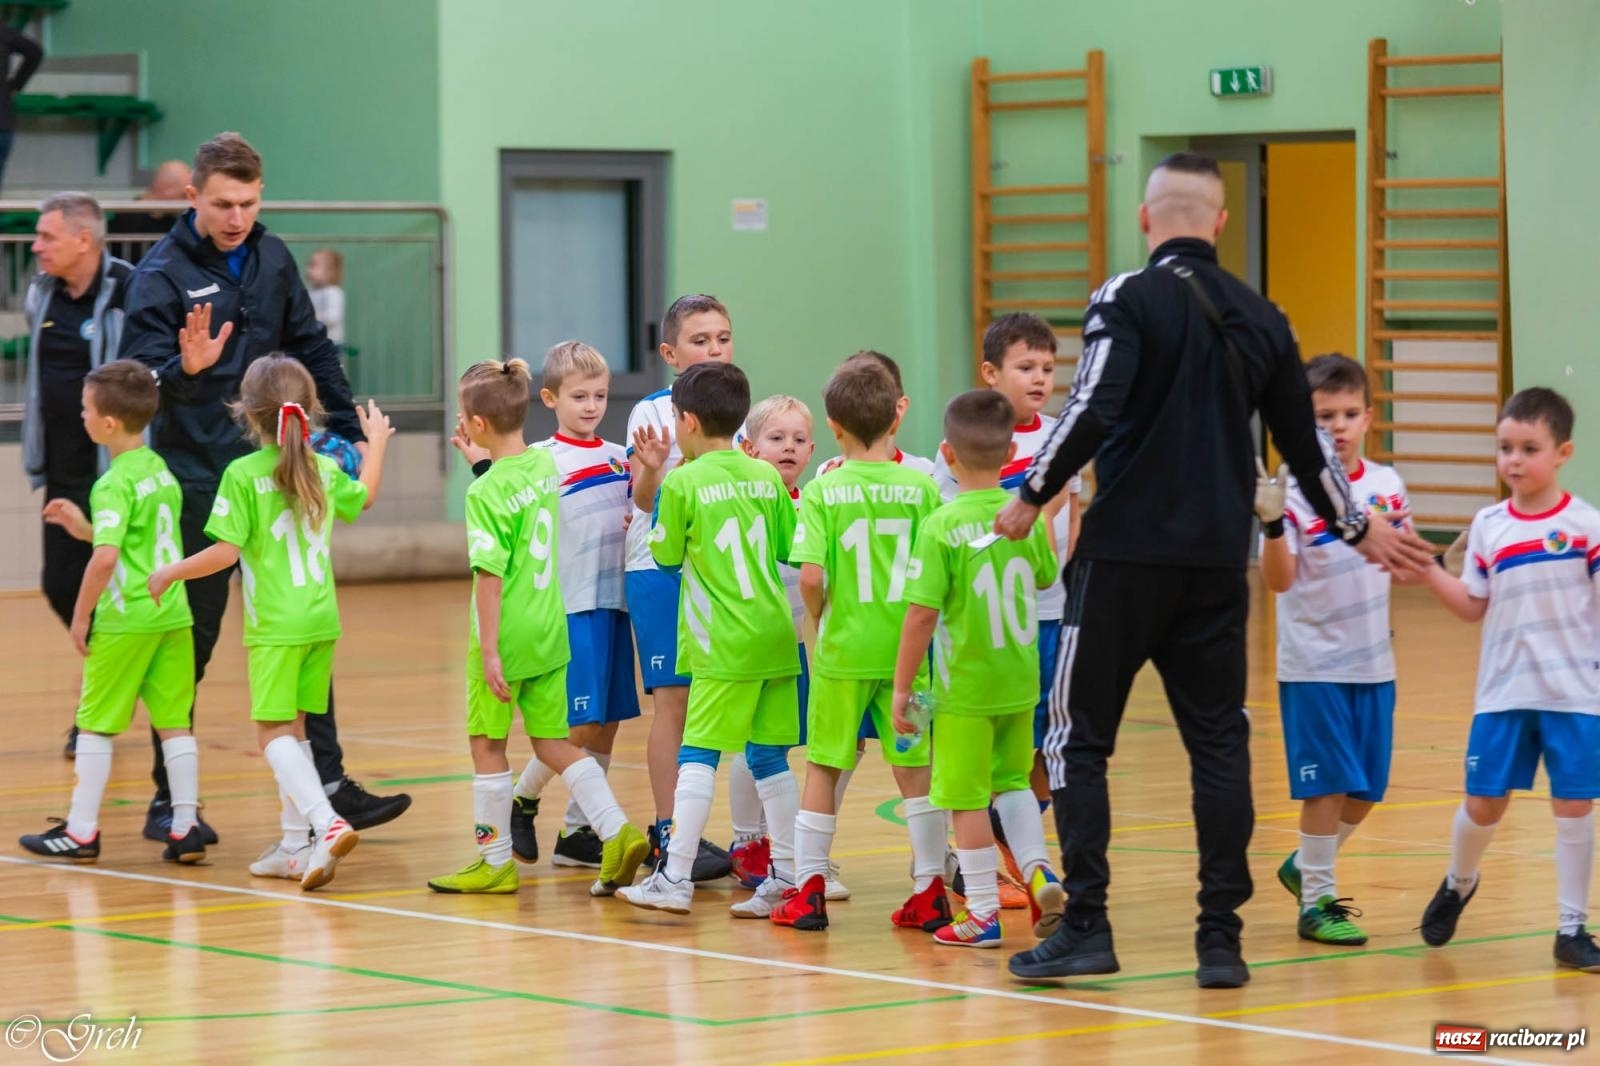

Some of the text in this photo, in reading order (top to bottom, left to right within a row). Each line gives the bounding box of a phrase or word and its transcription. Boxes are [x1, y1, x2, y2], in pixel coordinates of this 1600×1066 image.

[698, 480, 736, 504] UNIA
[823, 484, 864, 506] UNIA
[154, 503, 182, 571] 8
[270, 508, 330, 587] 18
[529, 507, 553, 590] 9
[713, 513, 779, 600] 11
[840, 518, 913, 603] 17
[972, 556, 1036, 649] 10
